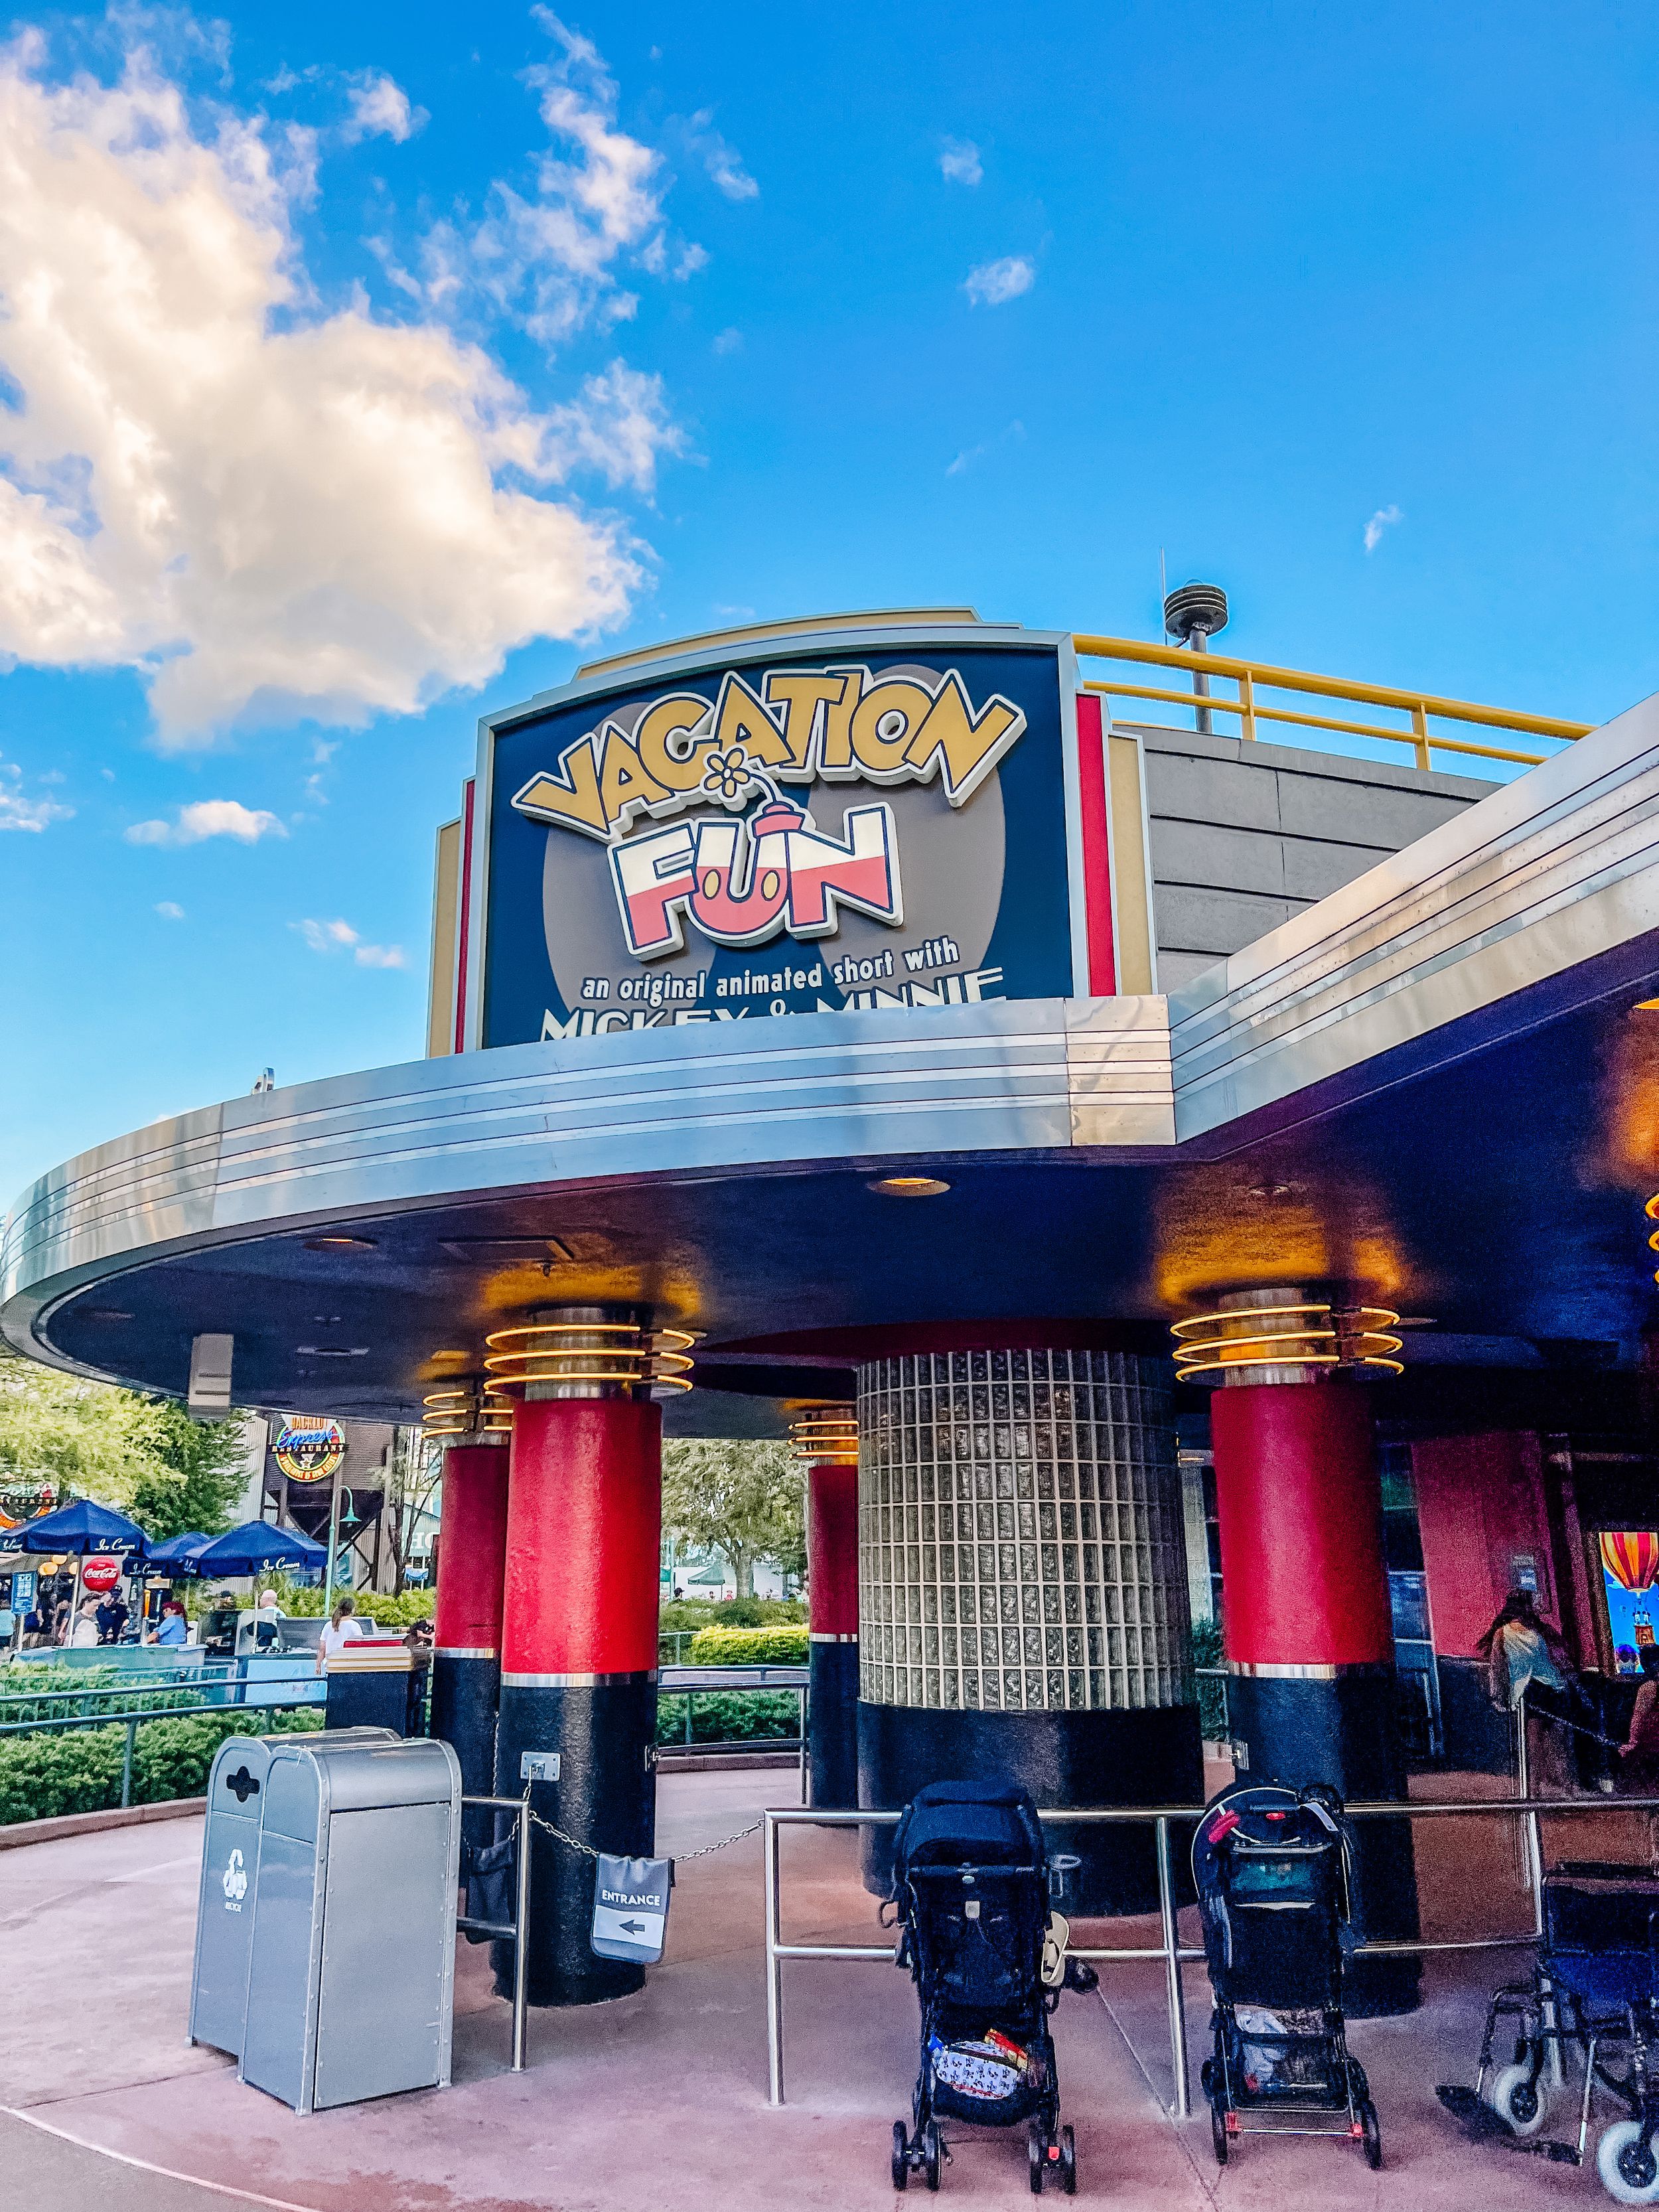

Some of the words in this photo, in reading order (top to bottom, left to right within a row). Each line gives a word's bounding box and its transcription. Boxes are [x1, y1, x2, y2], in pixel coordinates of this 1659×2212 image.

[512, 666, 1025, 840] VACATION
[607, 801, 902, 960] FUN
[583, 978, 610, 998] an
[619, 972, 705, 1007] original
[716, 963, 822, 996] animated
[833, 951, 893, 984] short
[904, 937, 959, 971] with
[277, 1428, 340, 1449] Express
[95, 1538, 109, 1551] Ice
[111, 1538, 135, 1550] Cream
[259, 1559, 274, 1572] Ice
[276, 1556, 300, 1570] Cream
[602, 1889, 660, 1906] ENTRANCE
